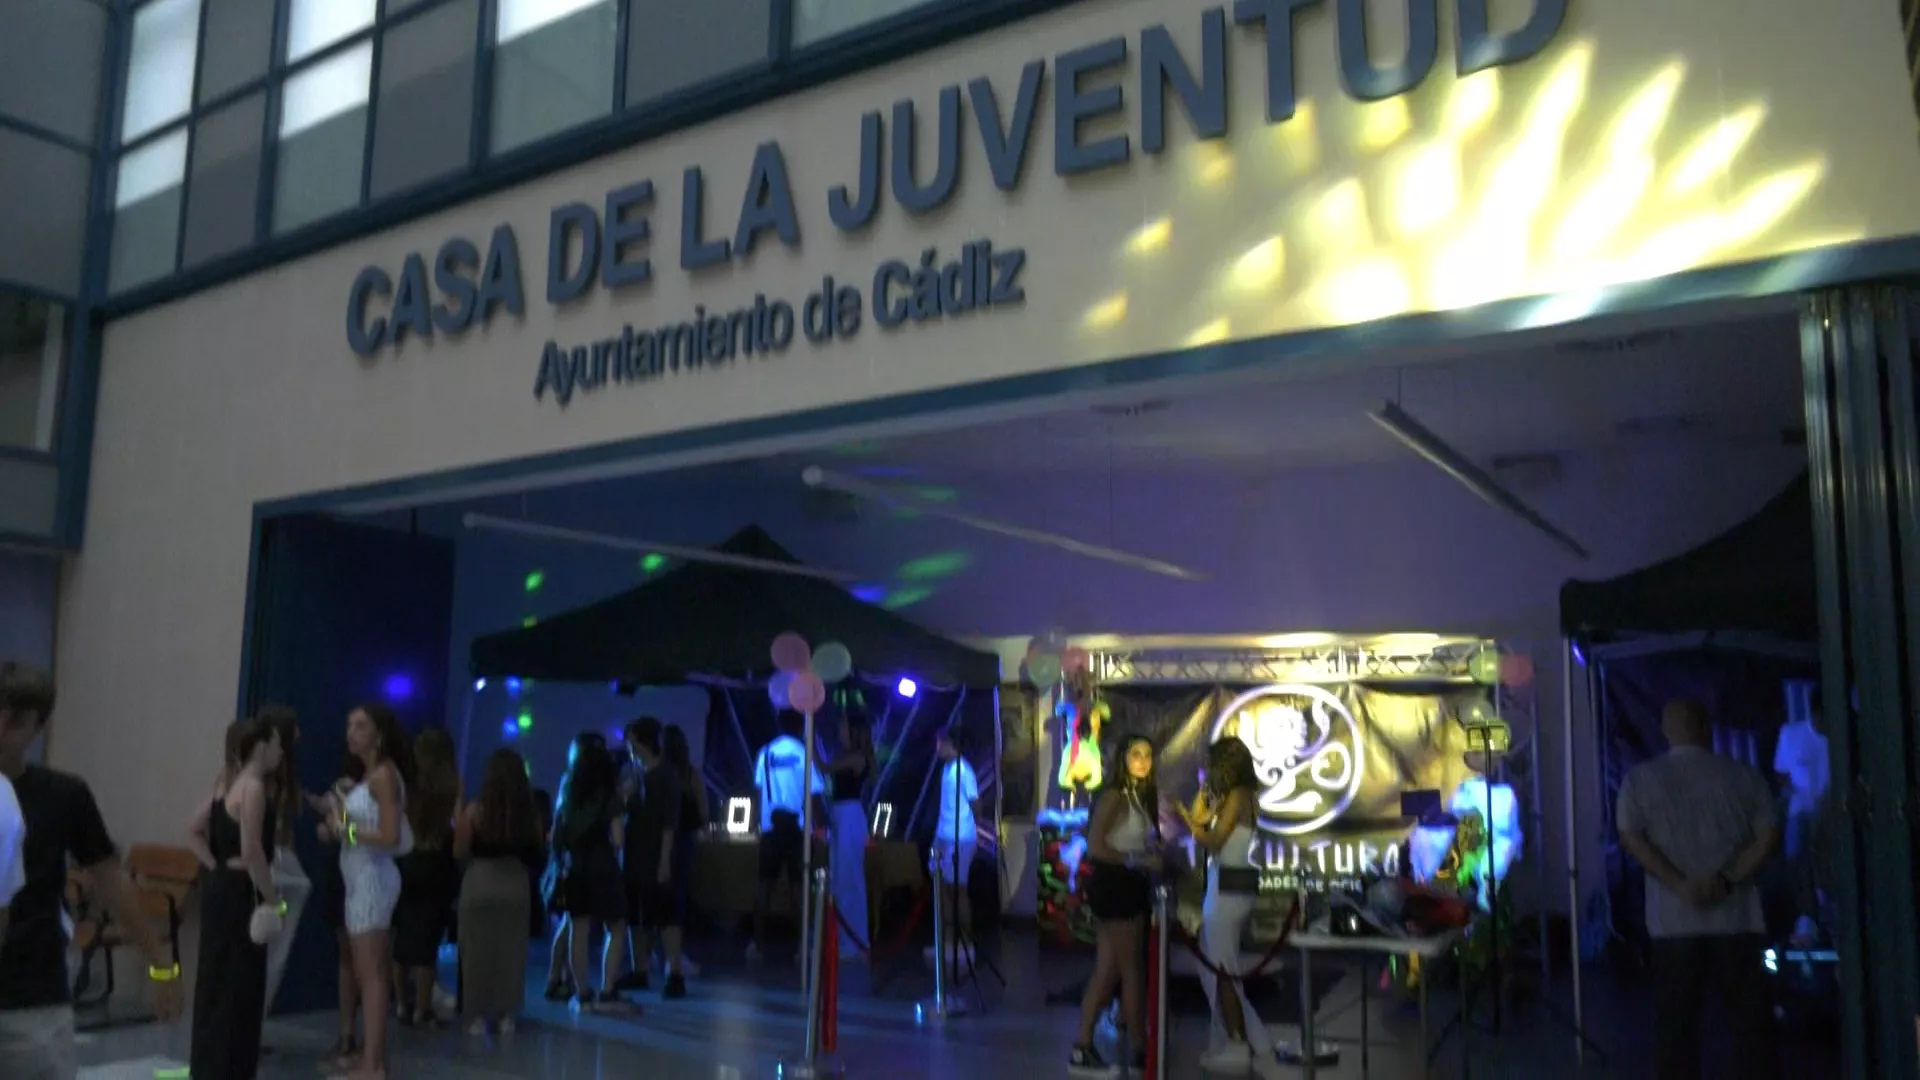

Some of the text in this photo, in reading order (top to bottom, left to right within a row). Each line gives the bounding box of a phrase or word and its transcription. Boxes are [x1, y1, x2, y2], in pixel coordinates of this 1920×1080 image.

[347, 0, 1568, 357] CASA DE LA JUVENTUD
[533, 239, 1027, 406] Ayuntamiento de Cádiz
